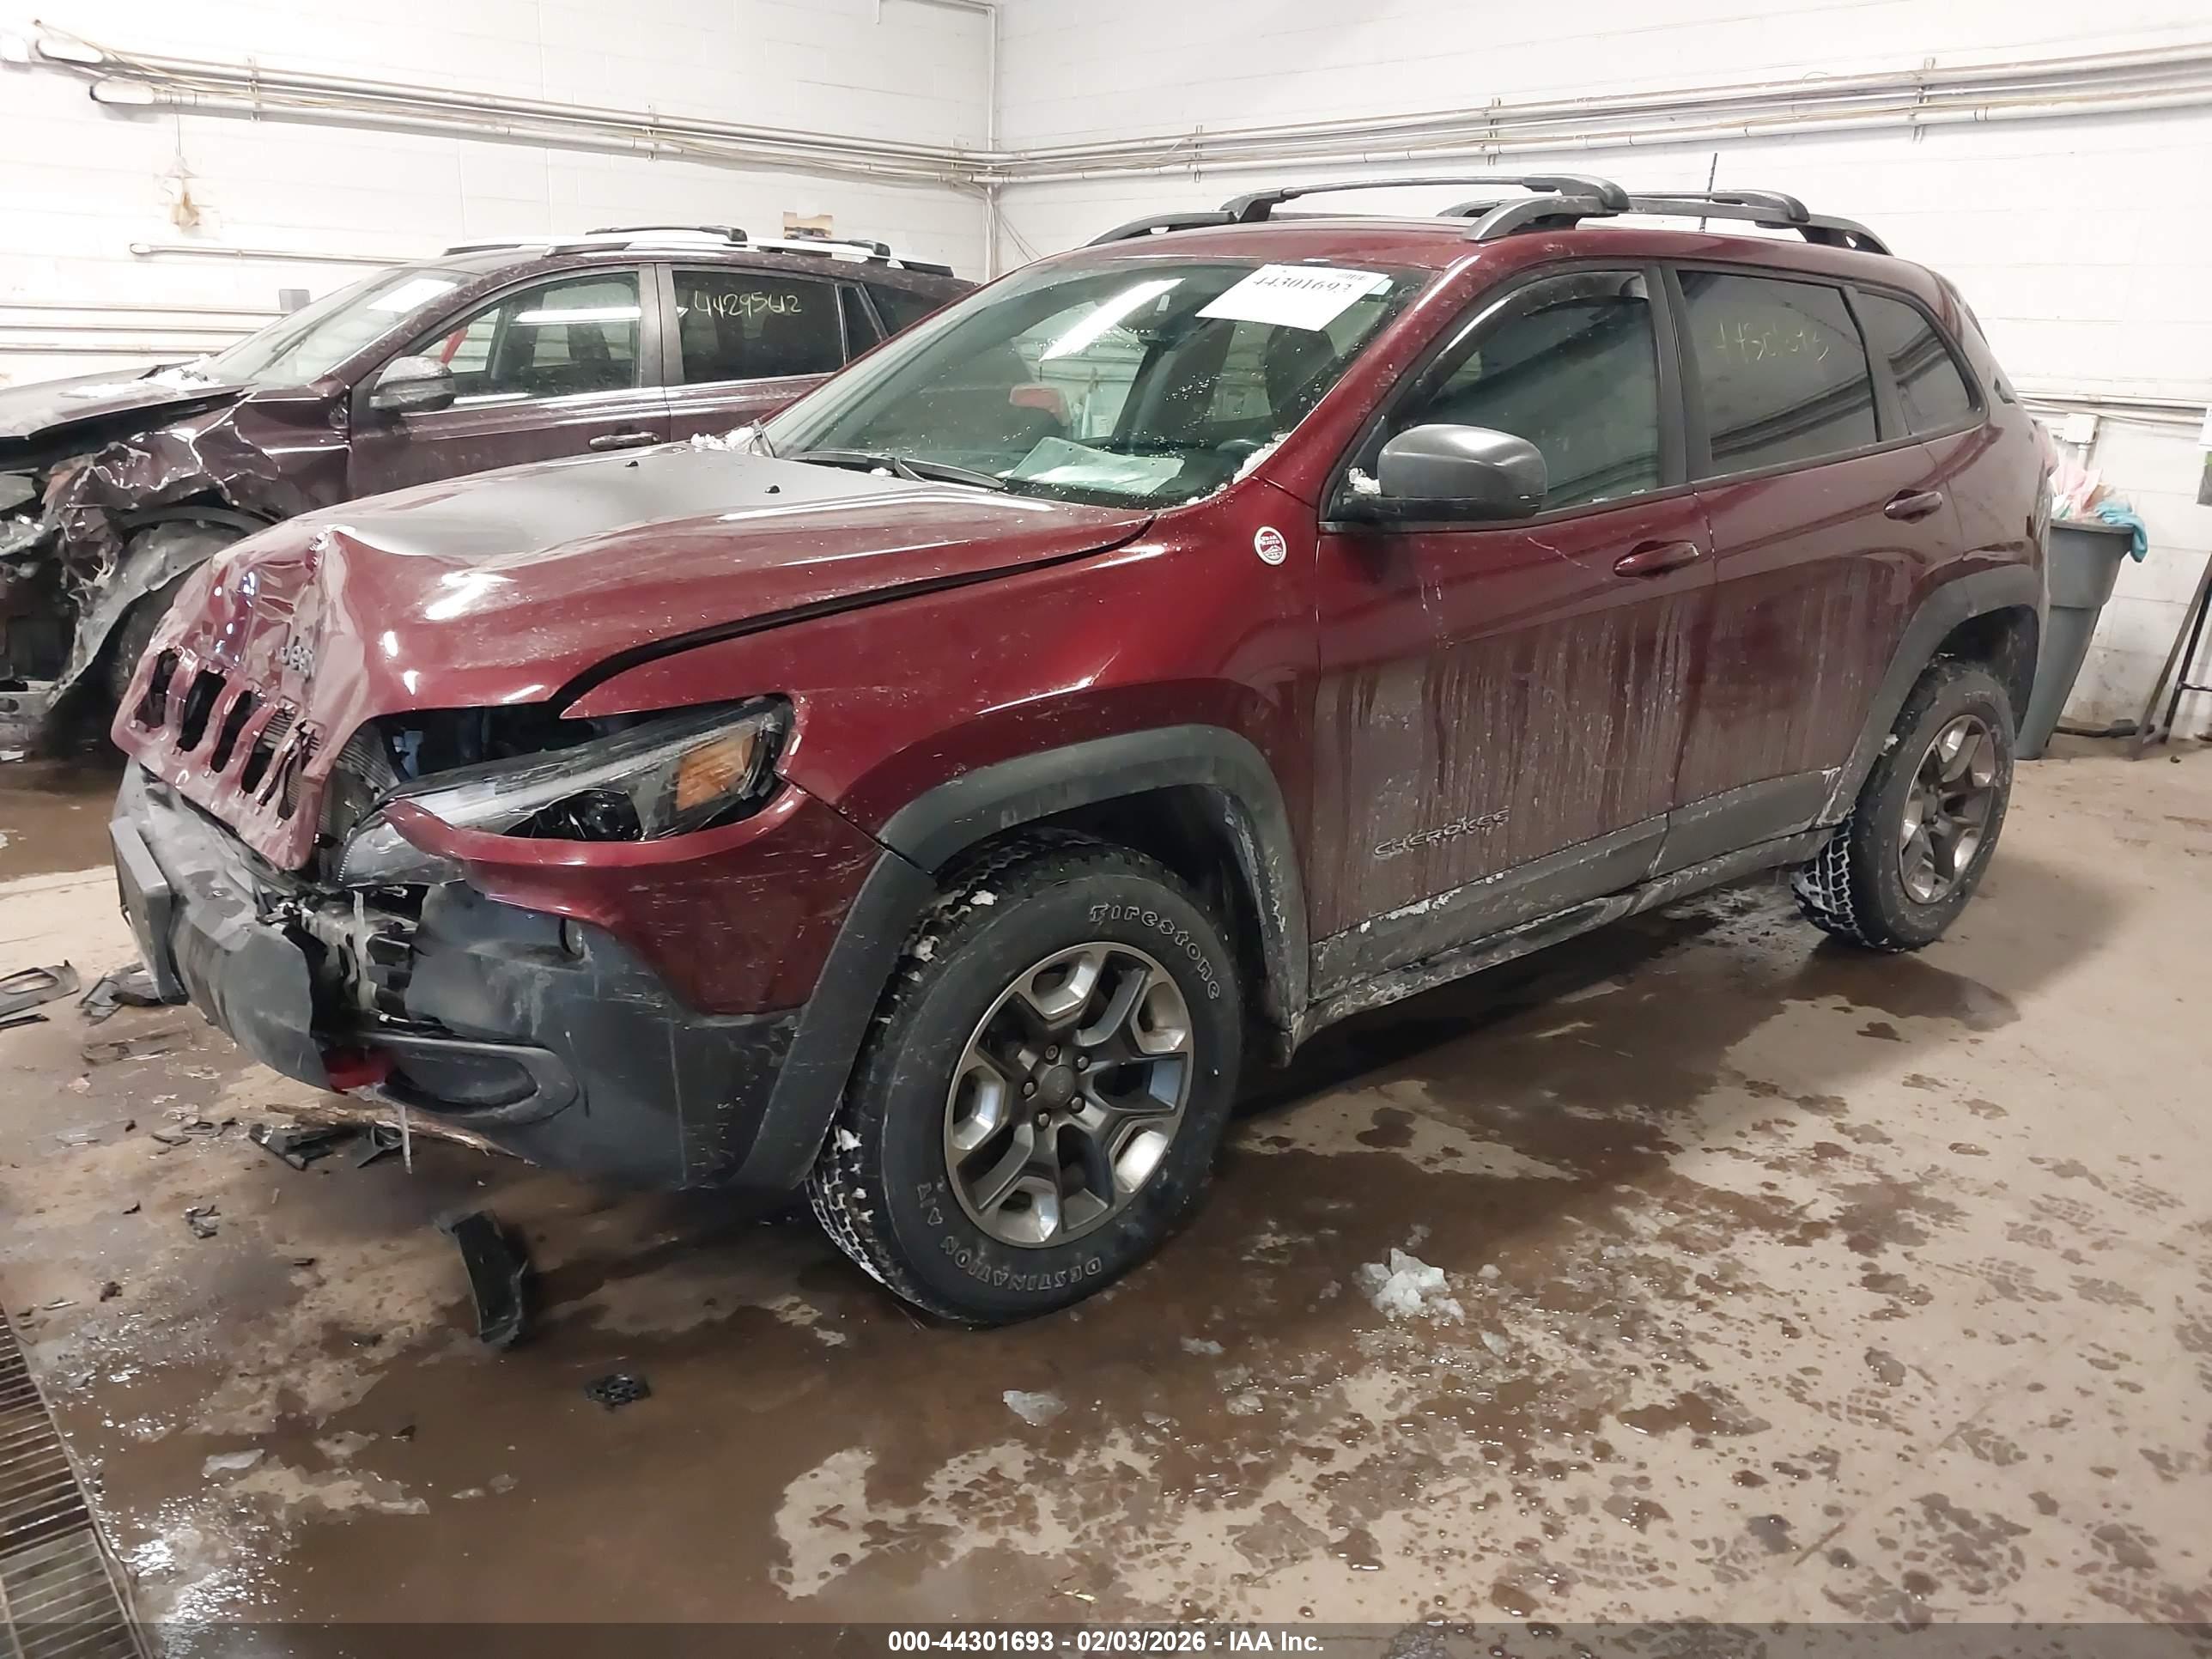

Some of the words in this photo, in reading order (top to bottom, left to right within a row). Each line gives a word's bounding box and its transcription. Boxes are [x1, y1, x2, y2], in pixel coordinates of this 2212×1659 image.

[694, 289, 802, 319] 44295612
[1374, 807, 1510, 858] CHEROKEE
[1089, 902, 1220, 1000] Firestone
